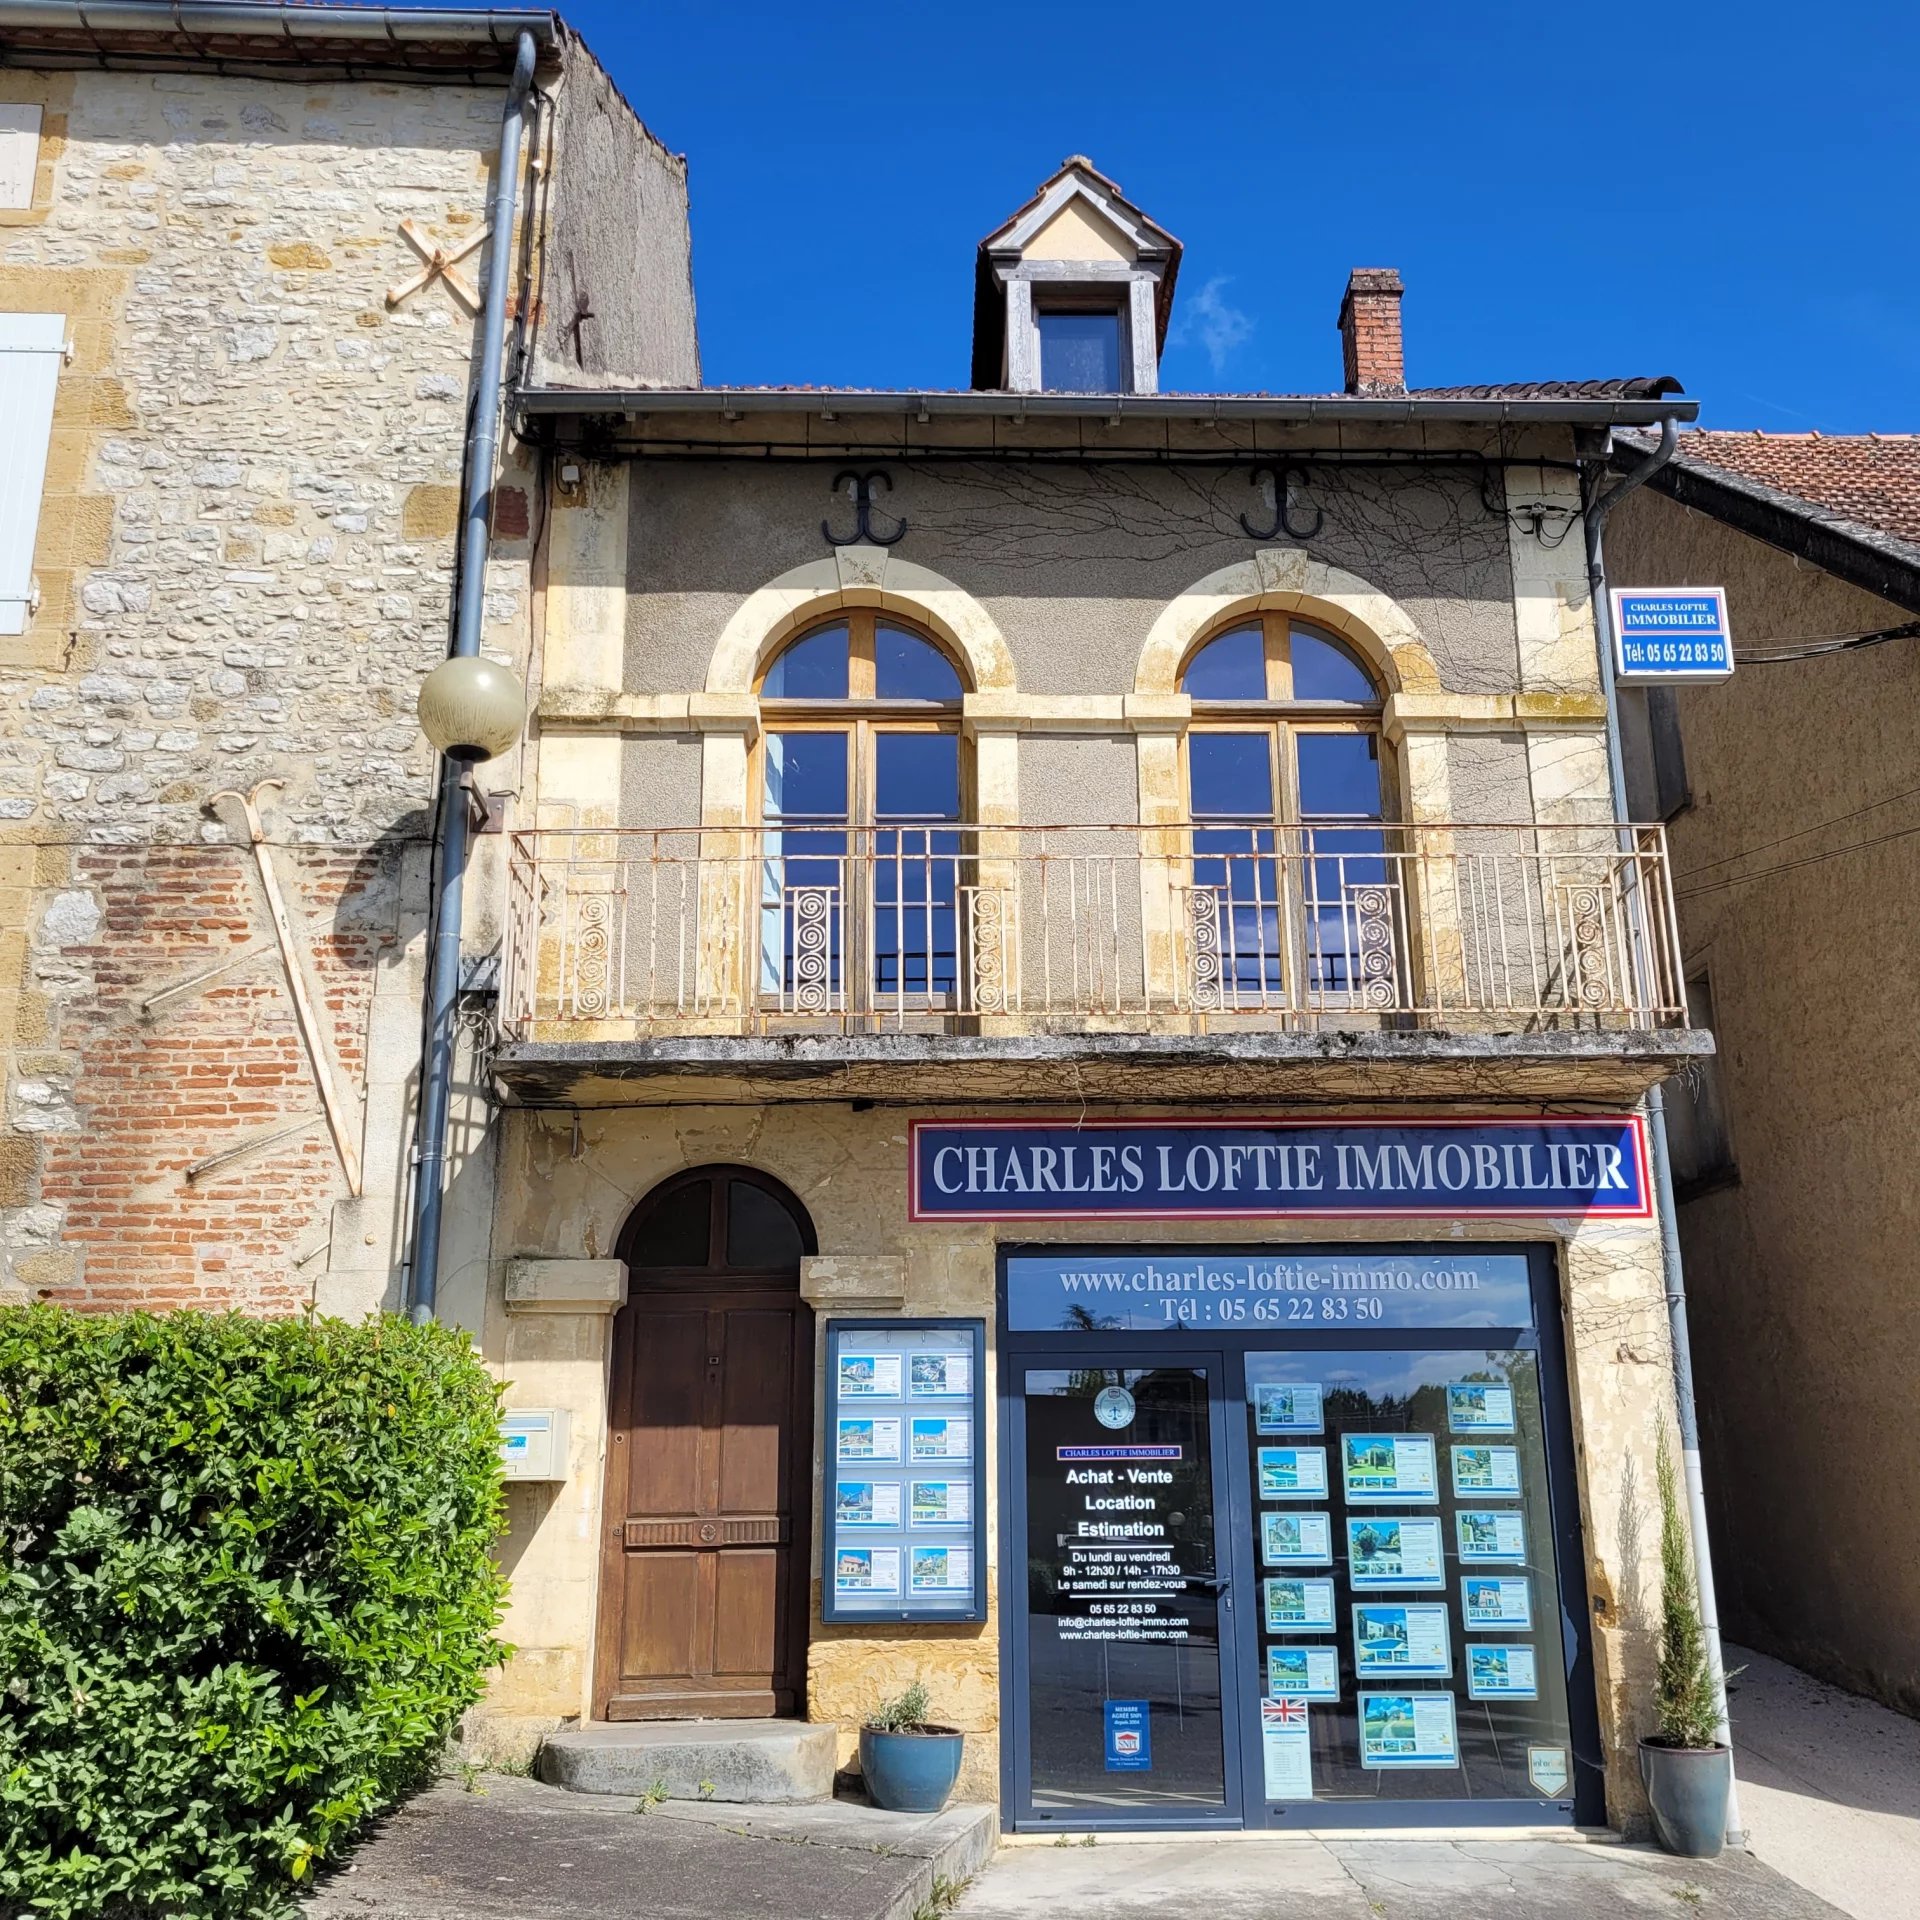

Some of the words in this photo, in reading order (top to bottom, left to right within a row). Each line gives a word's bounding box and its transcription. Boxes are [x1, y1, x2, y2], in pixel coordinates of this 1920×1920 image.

[1630, 603, 1673, 612] CHARLES
[1675, 603, 1709, 611] LOFTIE
[1626, 614, 1717, 625] IMMOBILIER
[1625, 642, 1645, 661] Tél:
[1647, 643, 1660, 662] 05
[1663, 643, 1677, 662] 65
[1679, 643, 1693, 662] 22
[1695, 643, 1708, 662] 83
[1711, 643, 1724, 662] 50
[932, 1145, 1146, 1195] CHARLES
[1156, 1144, 1324, 1193] LOFTIE
[1335, 1143, 1630, 1191] IMMOBILIER
[1060, 1264, 1480, 1294] www.charles-loftie-immo.com
[1160, 1298, 1198, 1322] Tél
[1219, 1299, 1246, 1321] 05
[1253, 1298, 1280, 1320] 65
[1287, 1298, 1314, 1320] 22
[1321, 1298, 1348, 1320] 83
[1355, 1297, 1383, 1319] 50
[1065, 1448, 1100, 1457] CHARLES
[1101, 1448, 1128, 1456] LOFTIE
[1129, 1448, 1175, 1456] IMMOBILIER
[1066, 1469, 1114, 1484] Achat
[1127, 1469, 1173, 1484] Vente
[1085, 1495, 1156, 1510] Location
[1078, 1522, 1165, 1537] Estimation
[1072, 1552, 1087, 1562] Du
[1089, 1552, 1112, 1562] lundi
[1114, 1554, 1127, 1562] au
[1129, 1552, 1170, 1562] vendredi
[1063, 1566, 1076, 1576] 9h
[1085, 1566, 1115, 1576] 12h30
[1116, 1566, 1121, 1576] /
[1123, 1566, 1140, 1576] 14h
[1151, 1565, 1180, 1576] 17h30
[1058, 1580, 1070, 1590] Le
[1072, 1580, 1108, 1590] samedi
[1110, 1582, 1125, 1590] sur
[1127, 1579, 1187, 1590] rendez-vous
[1090, 1604, 1101, 1614] 05
[1103, 1604, 1115, 1614] 65
[1117, 1604, 1129, 1614] 22
[1131, 1604, 1143, 1614] 83
[1144, 1604, 1156, 1614] 50
[1058, 1617, 1189, 1629] info@charles-loftie-immo.com
[1060, 1630, 1188, 1640] www.charles-loftie-immo.com
